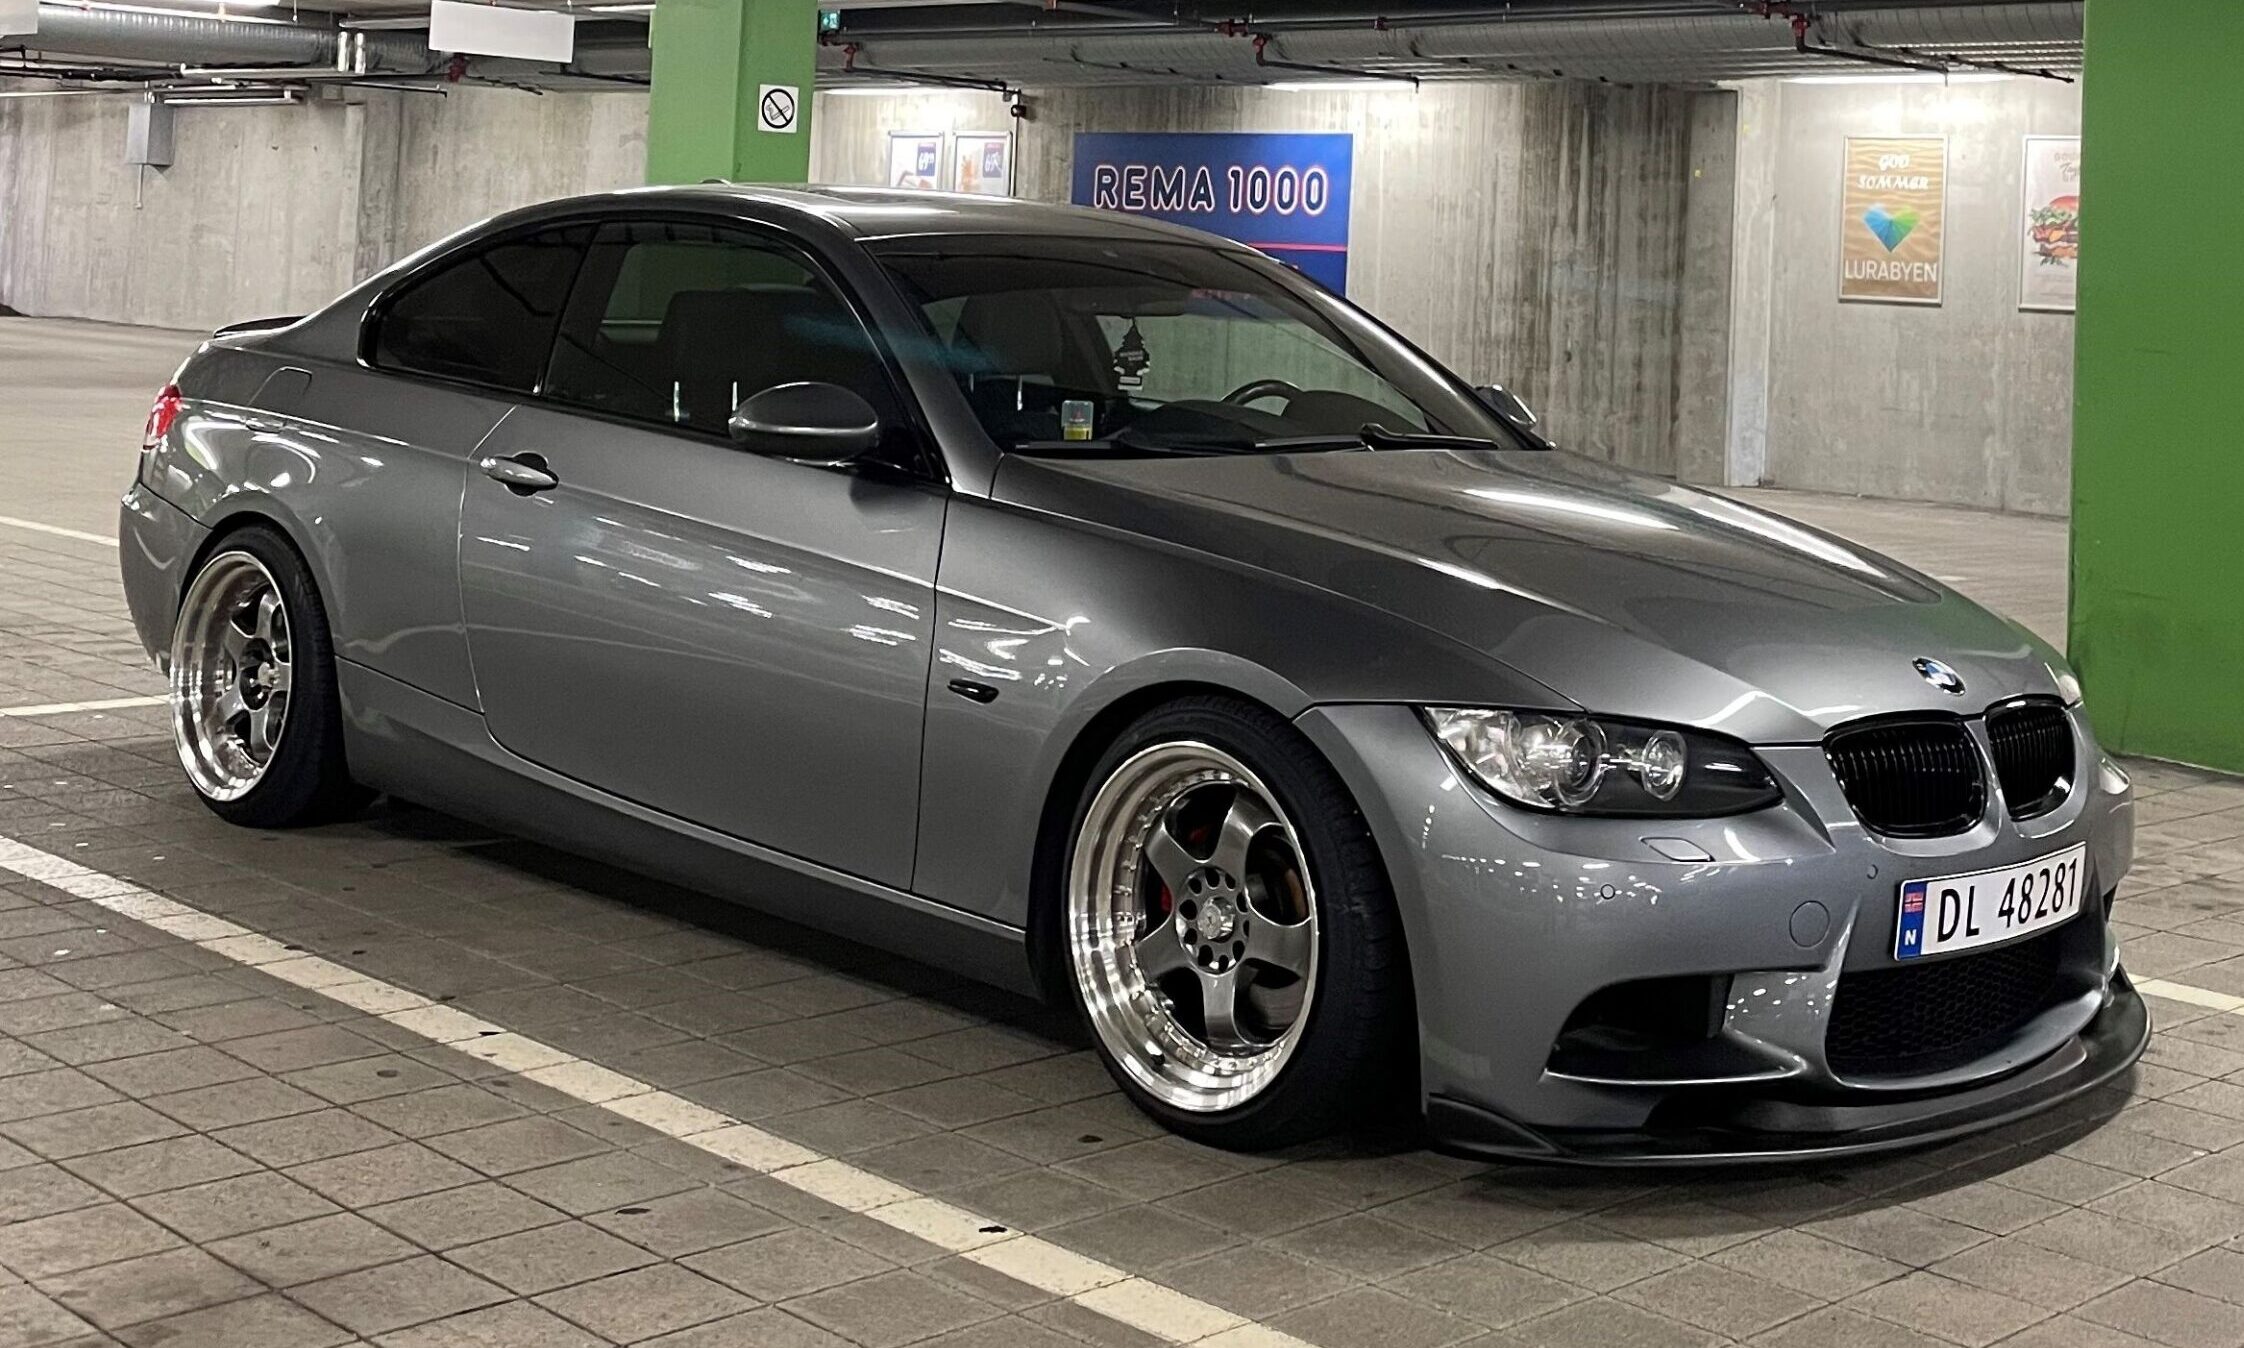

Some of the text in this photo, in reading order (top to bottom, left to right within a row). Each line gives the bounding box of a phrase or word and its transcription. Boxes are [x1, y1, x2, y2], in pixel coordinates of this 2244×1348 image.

[1879, 154, 1910, 170] GOD
[1093, 164, 1328, 215] REMA 1000
[1857, 175, 1929, 190] SOMMER
[1845, 260, 1937, 282] LURABYEN
[1937, 858, 2077, 942] DL 48281
[1905, 929, 1917, 946] N
